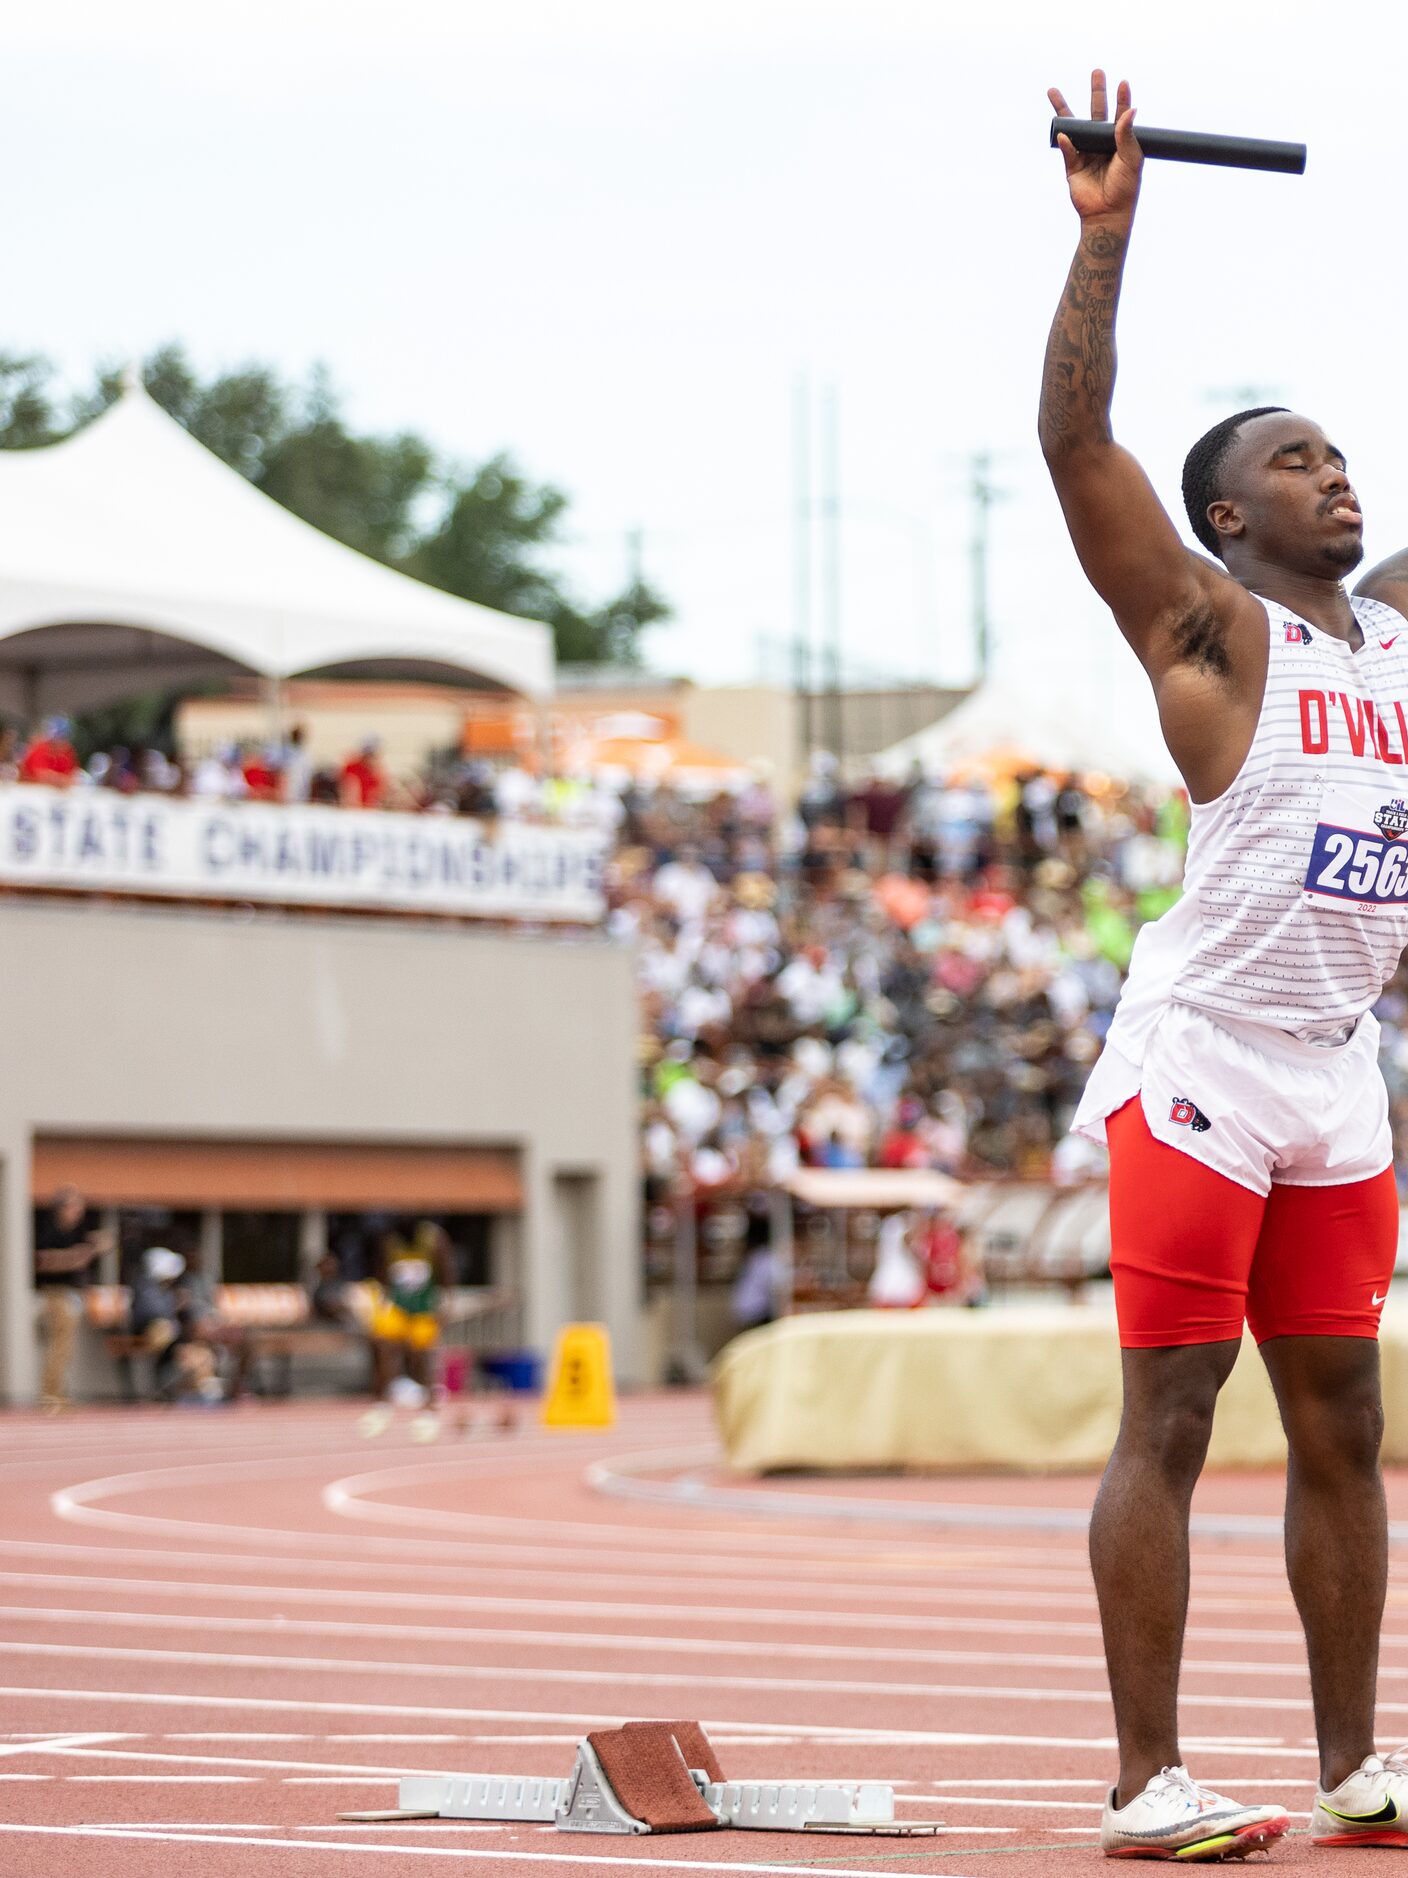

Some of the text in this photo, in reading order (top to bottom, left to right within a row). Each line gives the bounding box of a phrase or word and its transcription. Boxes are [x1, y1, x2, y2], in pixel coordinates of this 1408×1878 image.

[9, 802, 602, 894] STATE CHAMPIONSHIPS
[1357, 903, 1377, 912] 2022
